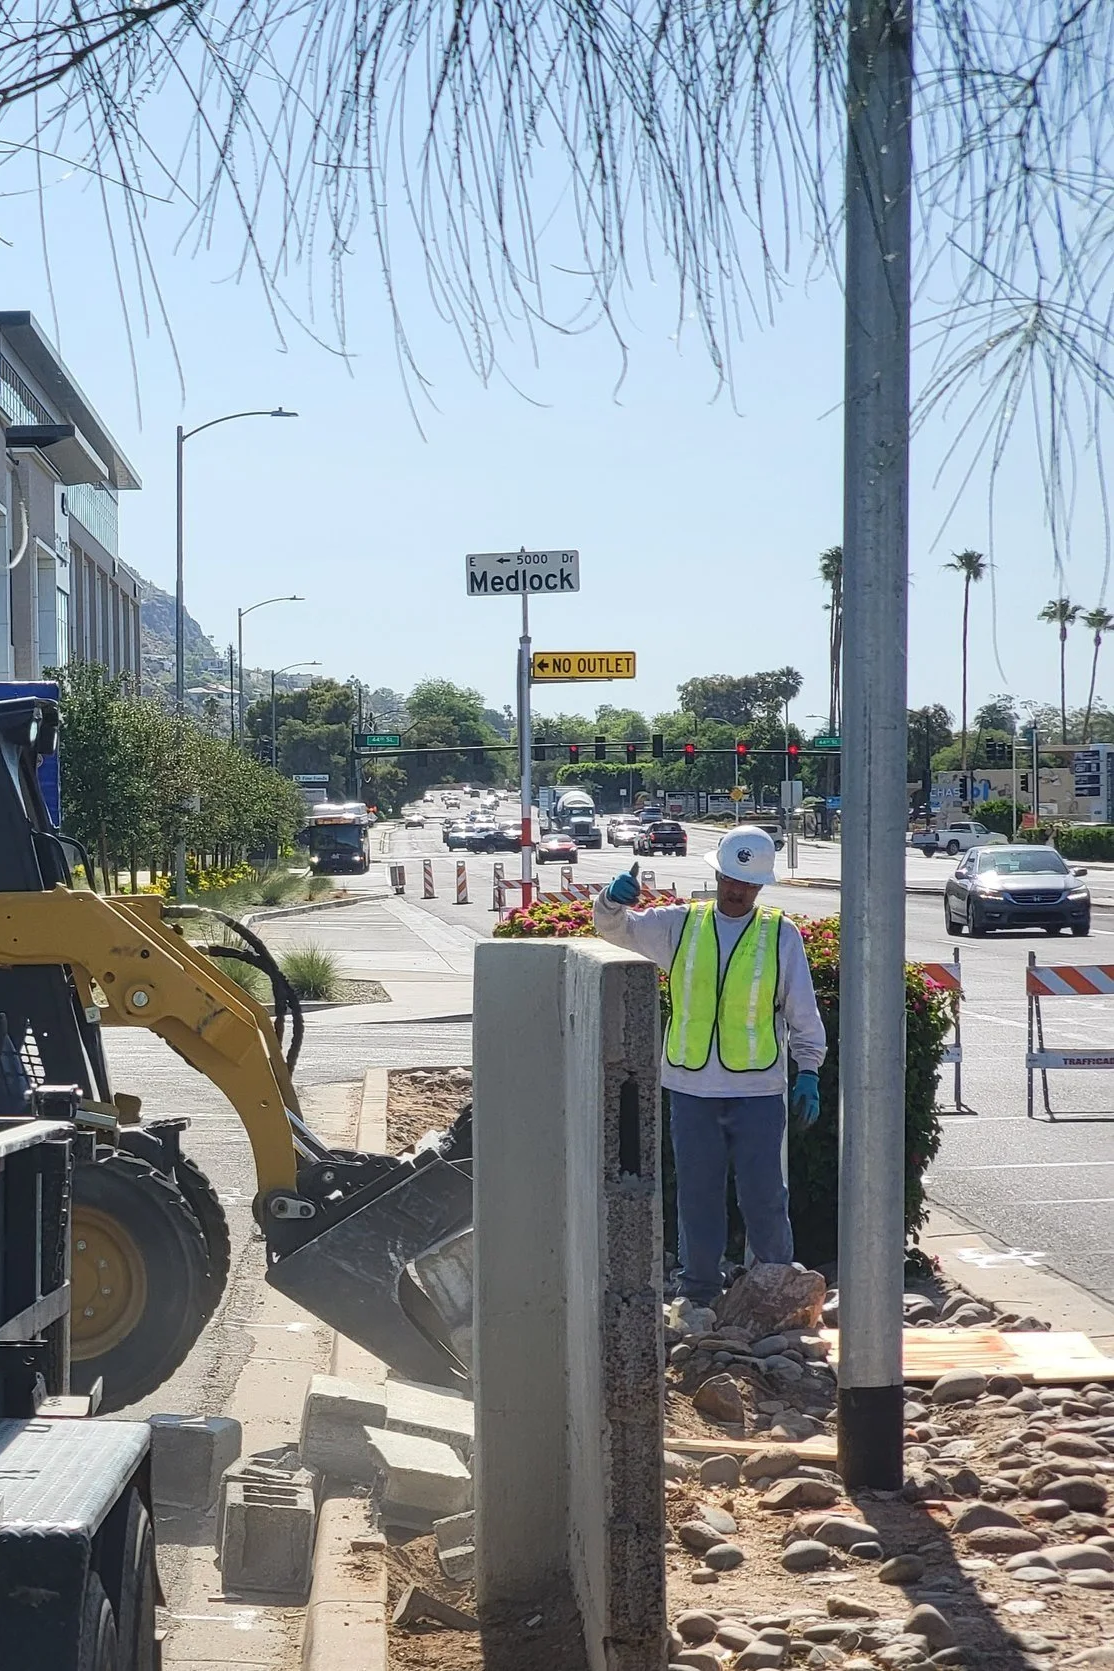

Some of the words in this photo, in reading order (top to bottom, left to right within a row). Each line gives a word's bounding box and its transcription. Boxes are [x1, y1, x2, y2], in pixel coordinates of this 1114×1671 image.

[469, 557, 477, 567] E
[516, 554, 548, 565] 5000
[561, 553, 574, 563] Dr
[470, 568, 575, 593] Medlock
[552, 658, 571, 673] NO
[577, 657, 632, 673] OUTLET
[930, 787, 961, 797] CHAS
